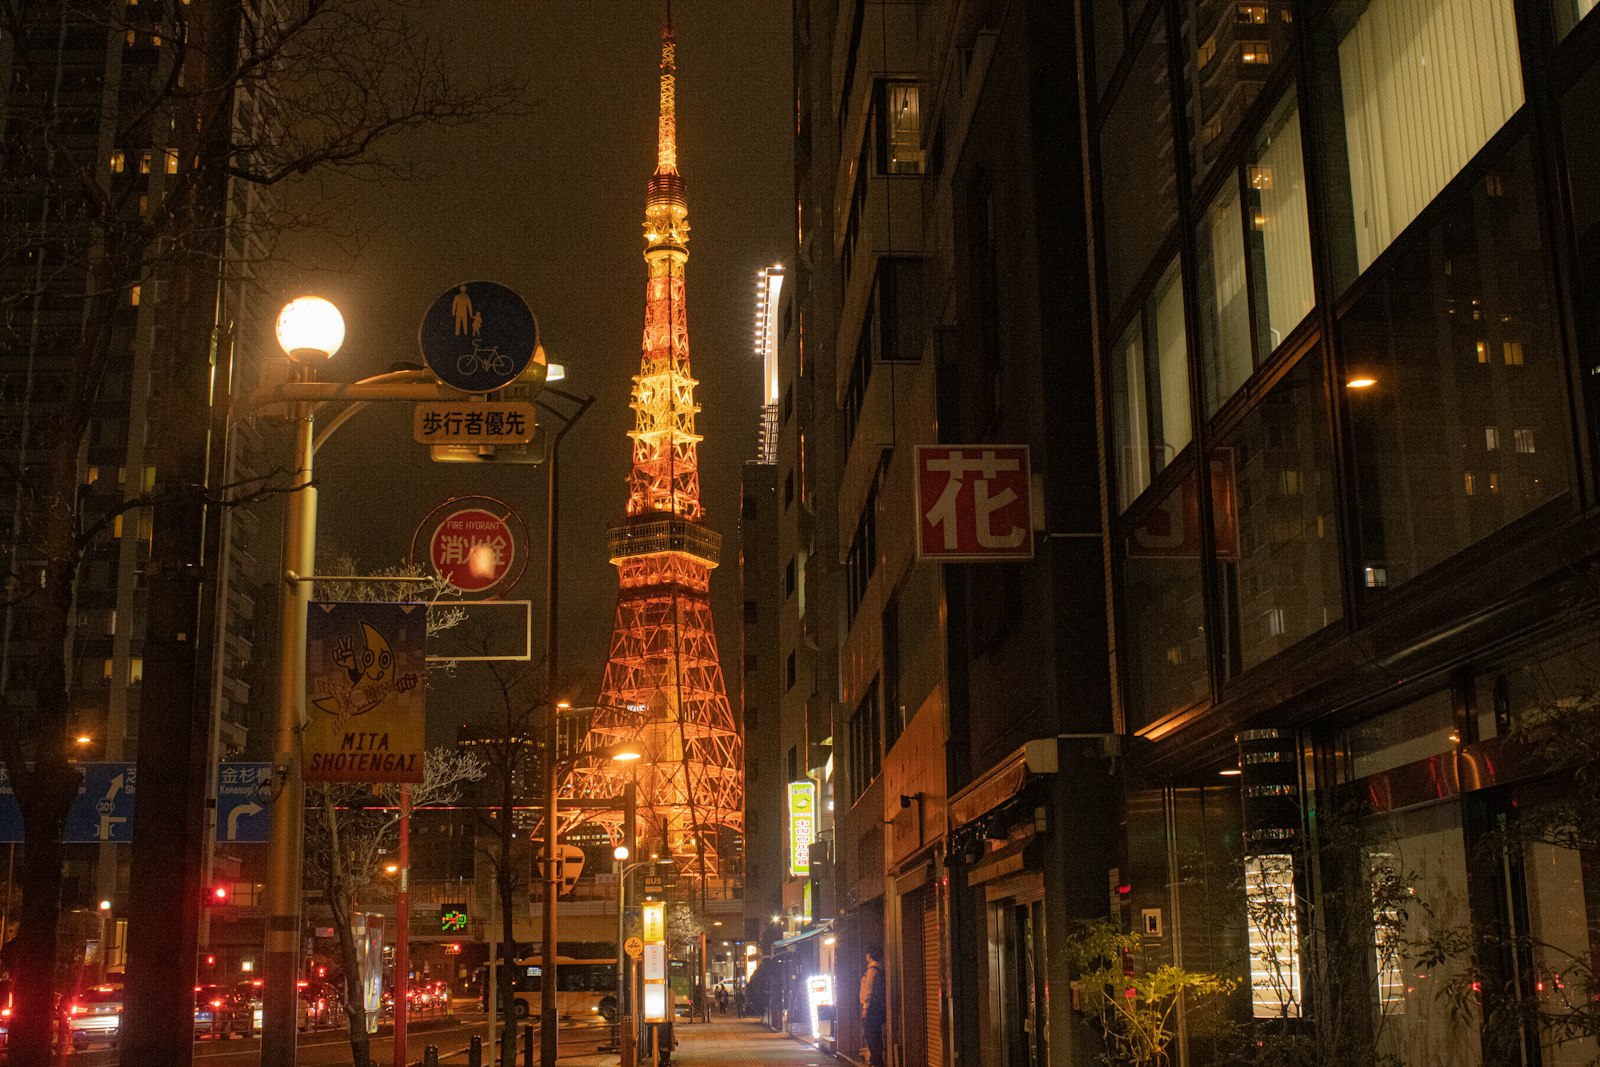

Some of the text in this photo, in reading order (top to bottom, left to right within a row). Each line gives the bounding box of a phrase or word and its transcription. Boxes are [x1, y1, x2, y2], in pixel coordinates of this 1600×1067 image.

[423, 411, 525, 435] 歩行者優先
[925, 450, 1026, 550] 花
[447, 521, 500, 530] FIRE HYDRANT
[439, 534, 507, 565] 消火栓
[341, 731, 390, 751] MITA
[310, 752, 417, 772] SHOTENGAI
[219, 785, 254, 796] Kanasugi
[645, 877, 662, 885] BUS
